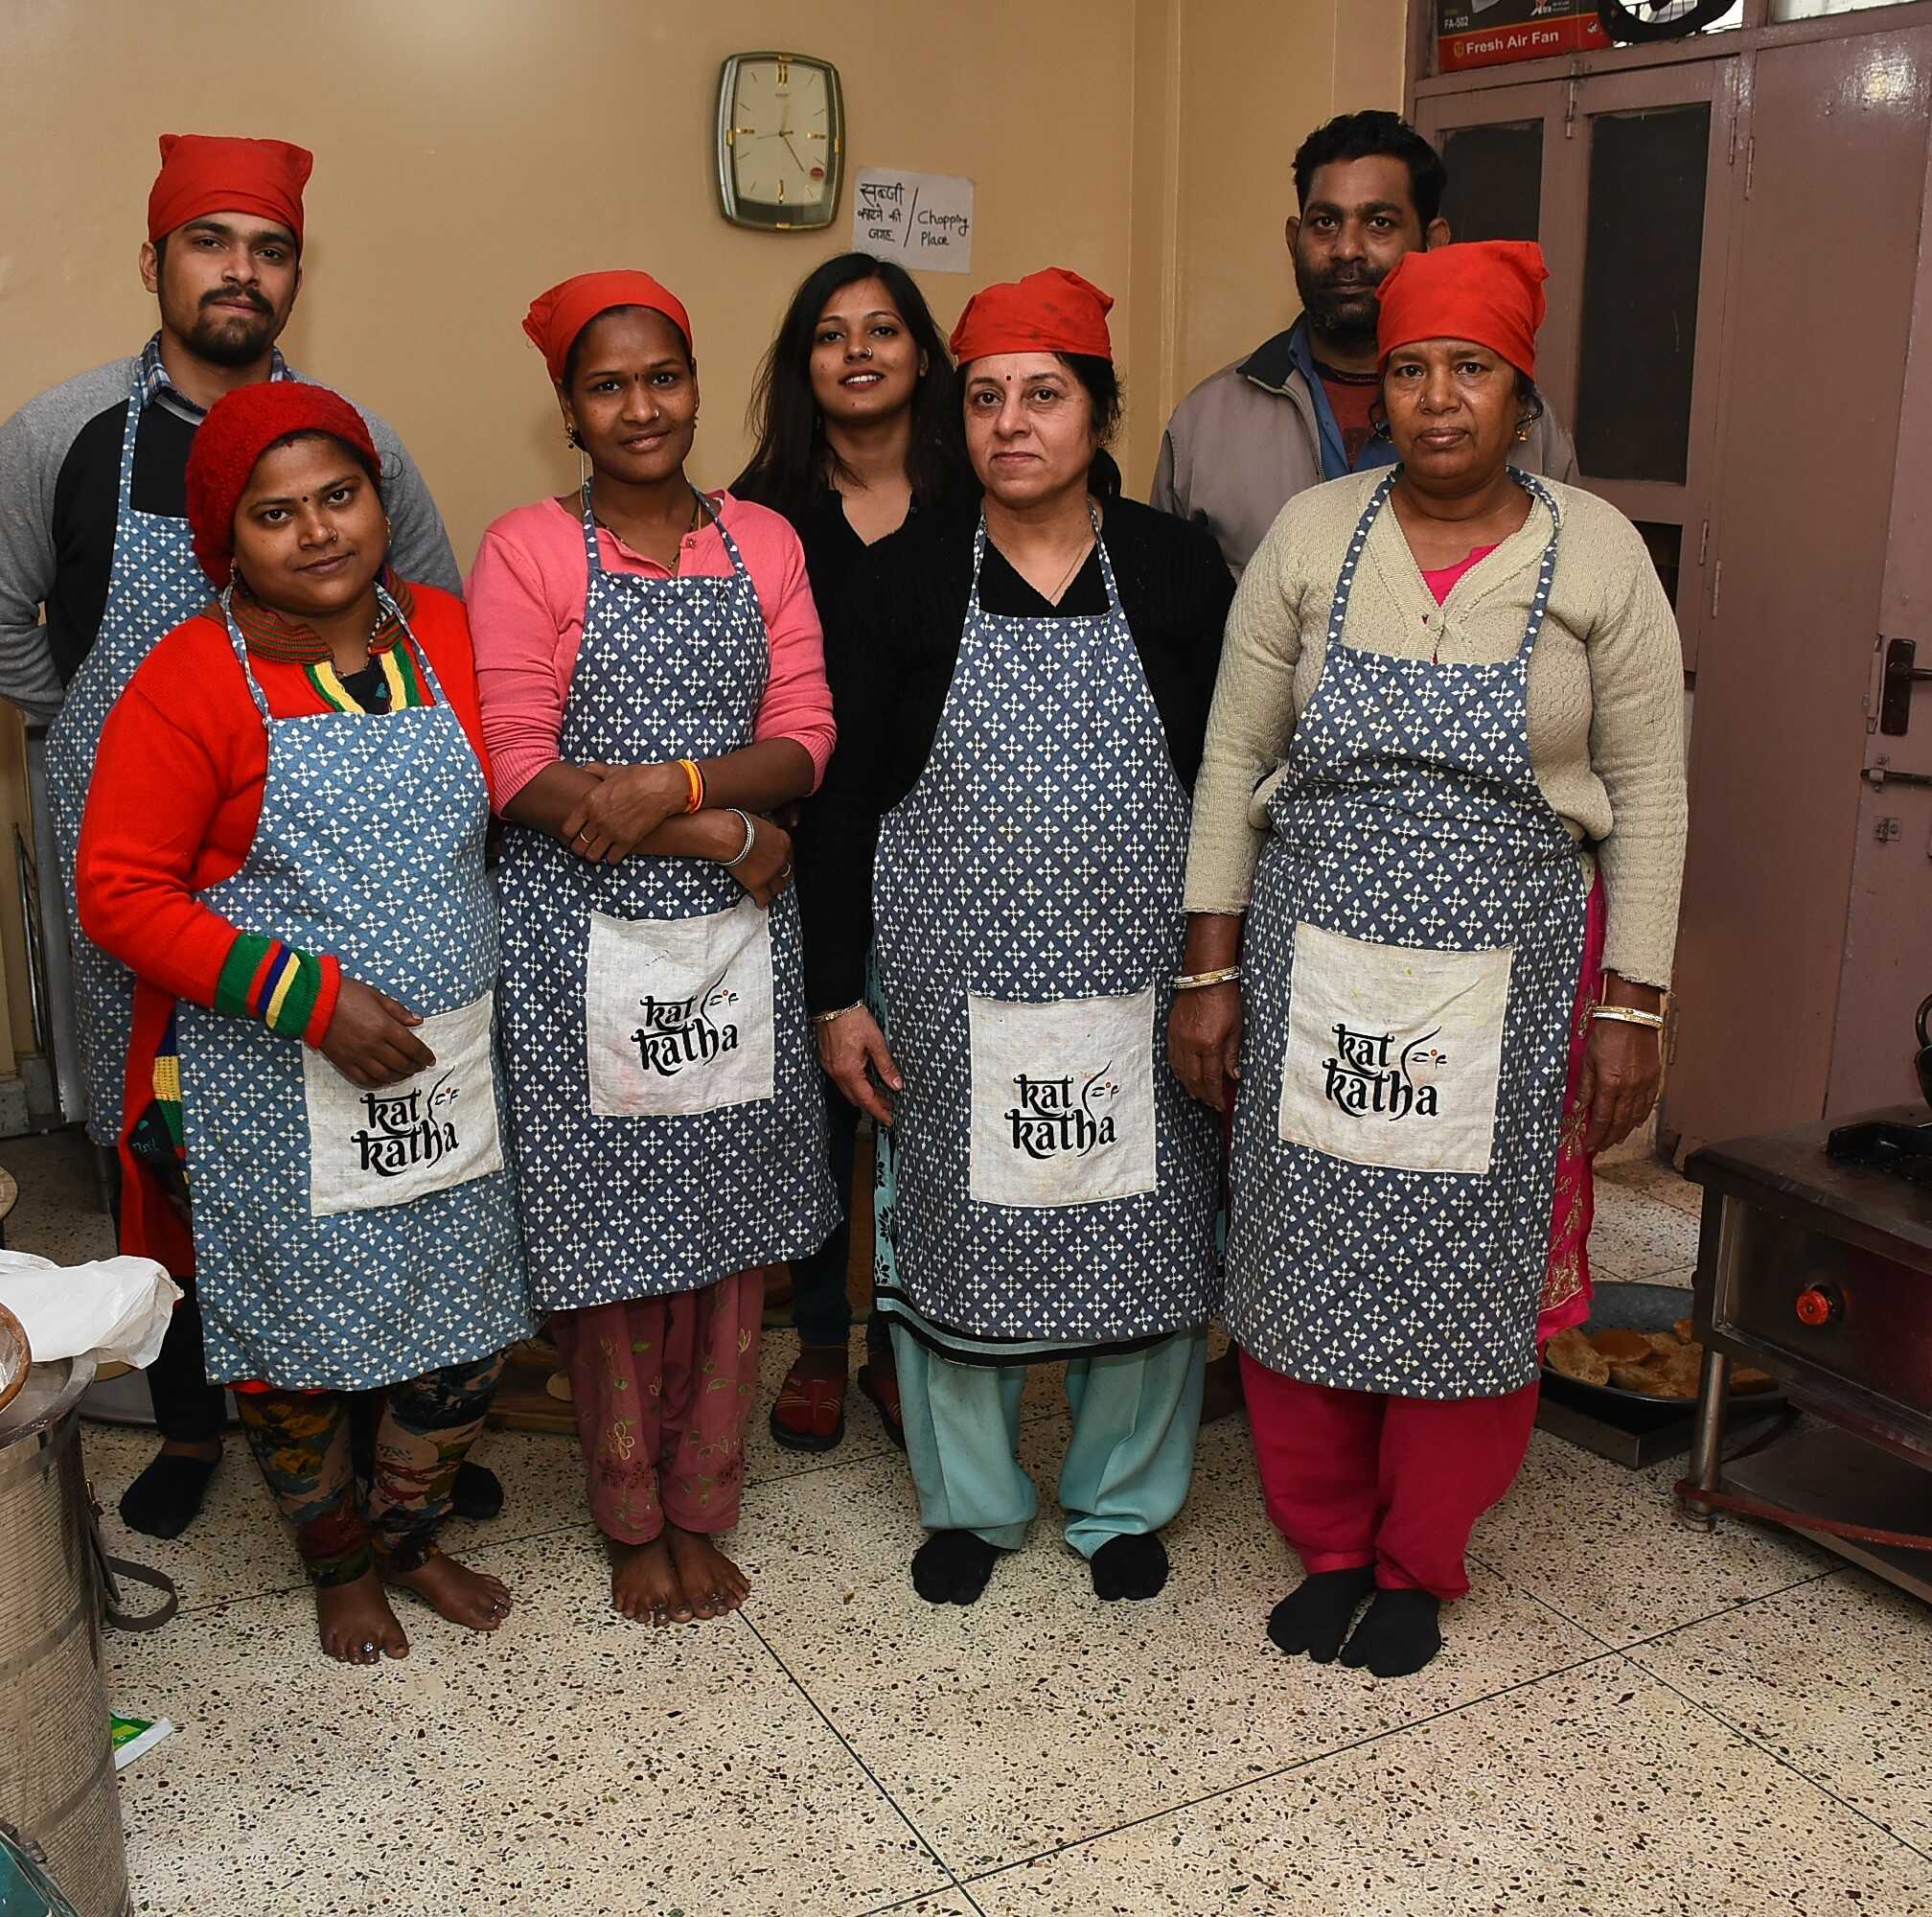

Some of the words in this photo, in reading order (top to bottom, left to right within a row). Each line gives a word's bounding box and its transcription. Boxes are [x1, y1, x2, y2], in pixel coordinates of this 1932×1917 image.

[1466, 38, 1504, 55] Fresh
[1506, 35, 1529, 49] Air
[1531, 31, 1559, 44] Fan
[888, 208, 902, 222] की
[917, 209, 969, 237] Chopping
[921, 231, 949, 246] Place
[640, 995, 698, 1031] kat
[631, 1018, 739, 1076] katha
[1331, 1023, 1395, 1075] kat
[359, 1087, 422, 1135] kat
[1013, 1074, 1073, 1118] kat
[1322, 1058, 1439, 1121] katha
[351, 1119, 460, 1177] katha
[1004, 1108, 1117, 1159] katha
